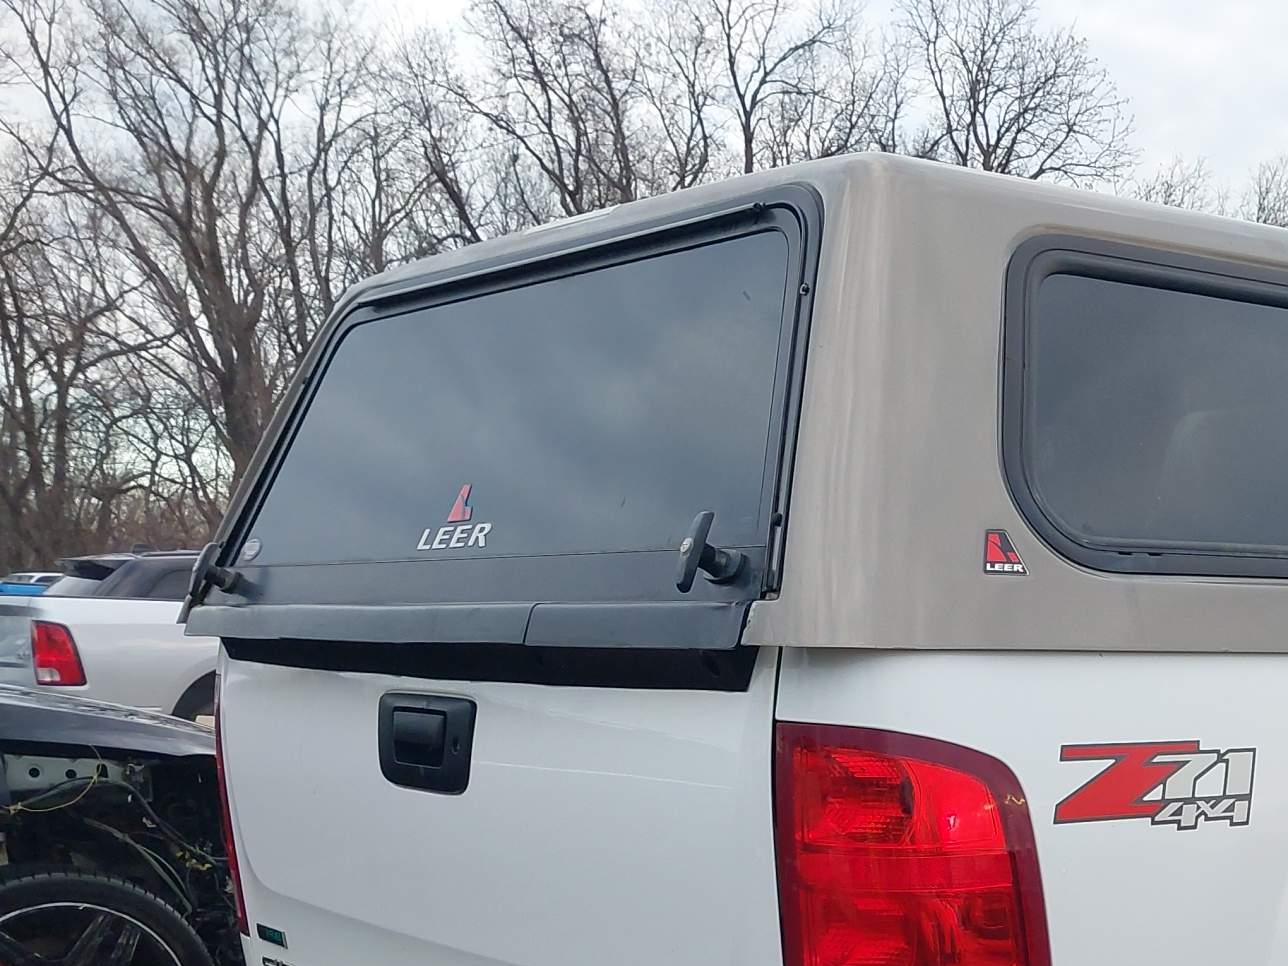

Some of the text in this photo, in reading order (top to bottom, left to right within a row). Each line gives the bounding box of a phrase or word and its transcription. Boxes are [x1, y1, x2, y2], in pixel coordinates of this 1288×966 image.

[417, 523, 492, 550] LEER
[986, 563, 1024, 573] LEER
[1053, 740, 1256, 824] Z71
